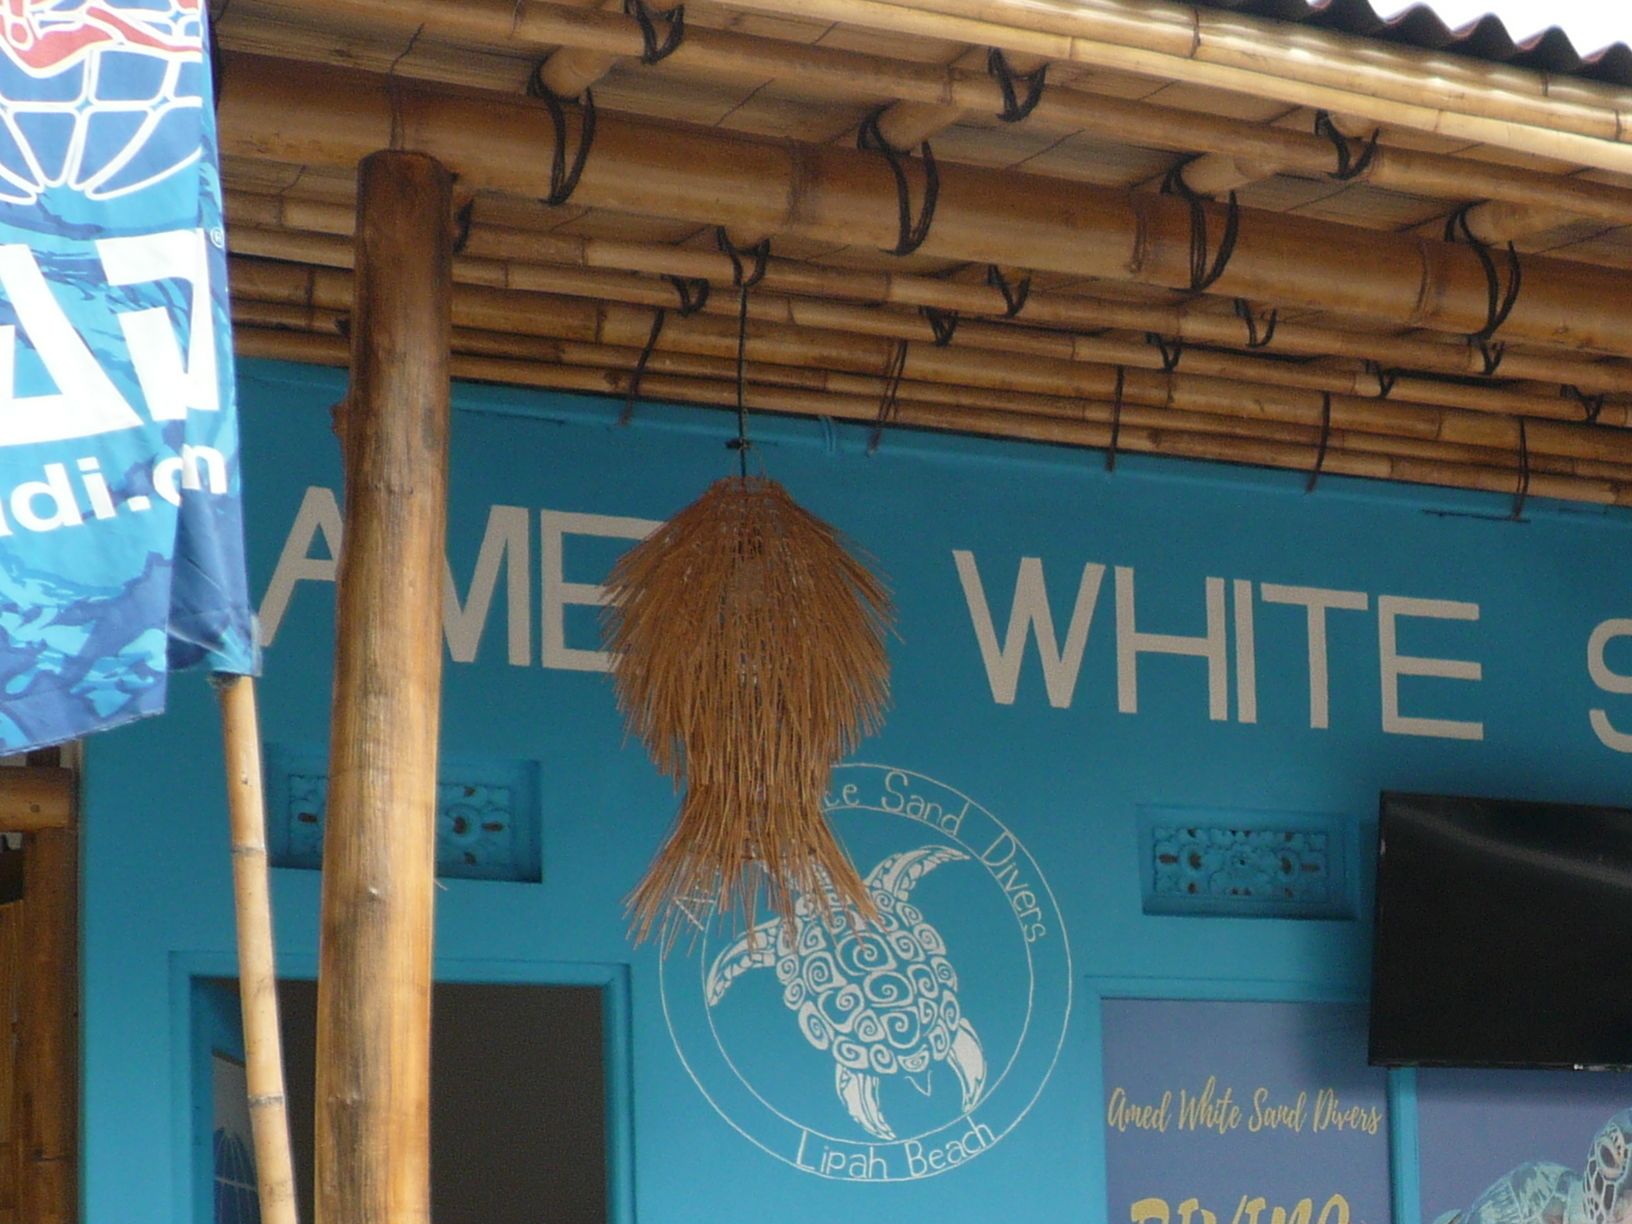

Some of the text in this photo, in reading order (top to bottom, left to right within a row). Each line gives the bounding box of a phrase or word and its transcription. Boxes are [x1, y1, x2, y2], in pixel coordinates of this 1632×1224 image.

[952, 550, 1484, 741] WHITE
[881, 771, 1046, 943] Sand Divers
[795, 1115, 996, 1179] Lipah Beach
[1108, 1075, 1382, 1136] Amed White Sand Divers
